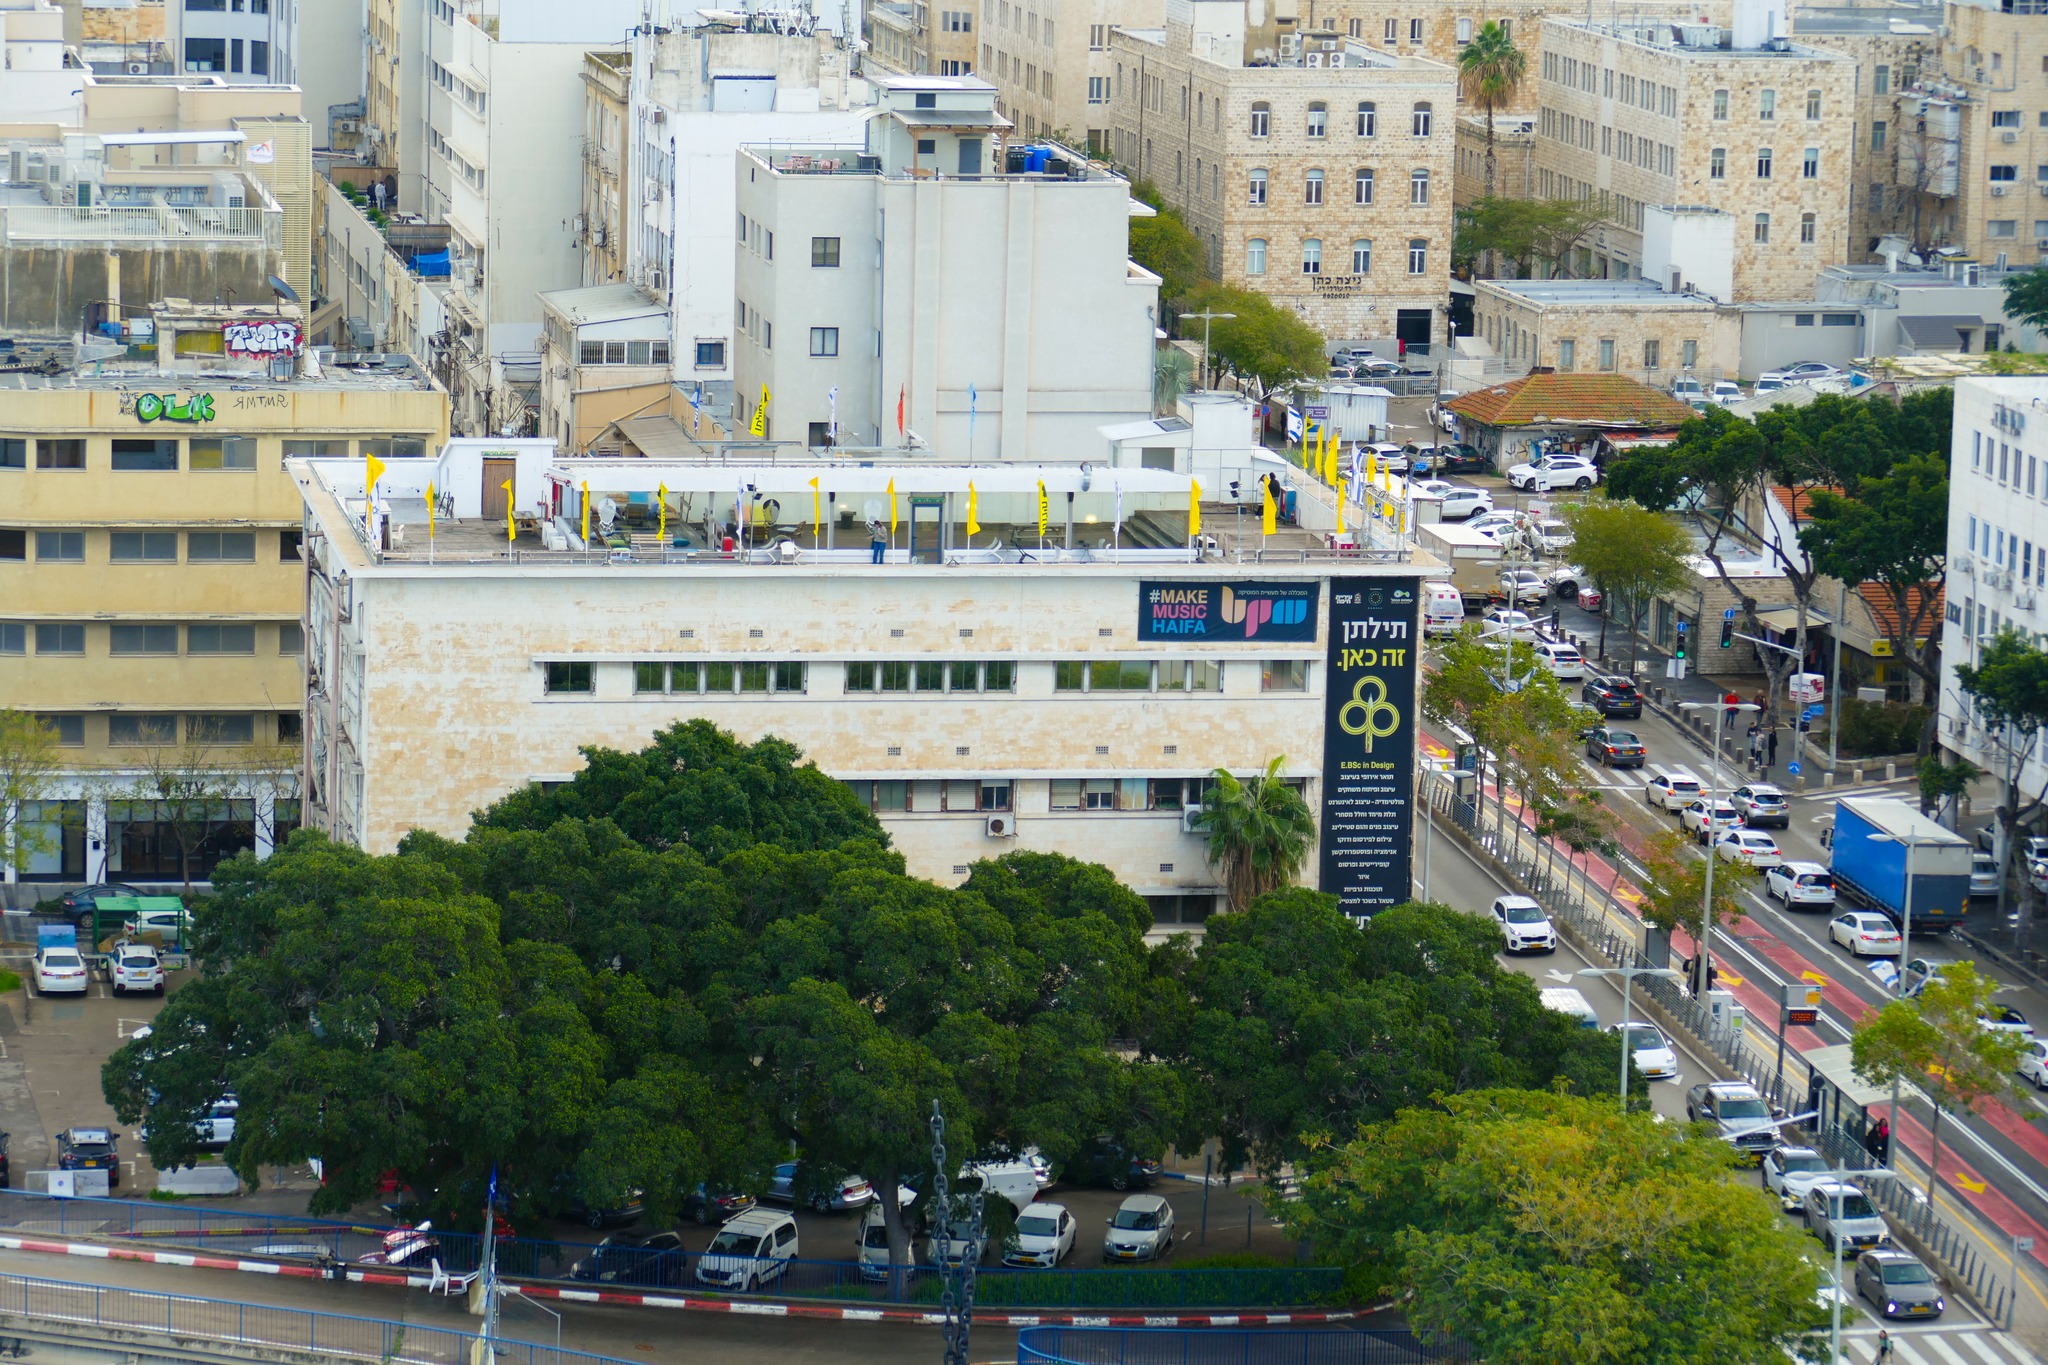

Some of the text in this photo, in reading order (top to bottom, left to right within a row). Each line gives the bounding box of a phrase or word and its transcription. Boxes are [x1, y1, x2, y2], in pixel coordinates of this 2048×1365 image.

[1312, 276, 1362, 291] ניצה כהן
[1150, 590, 1208, 604] #MAKE
[1153, 604, 1207, 619] MUSIC
[1152, 620, 1206, 634] HAIFA
[1342, 617, 1407, 644] תילתן
[1337, 649, 1406, 671] זה כאן.
[1371, 762, 1395, 770] Design
